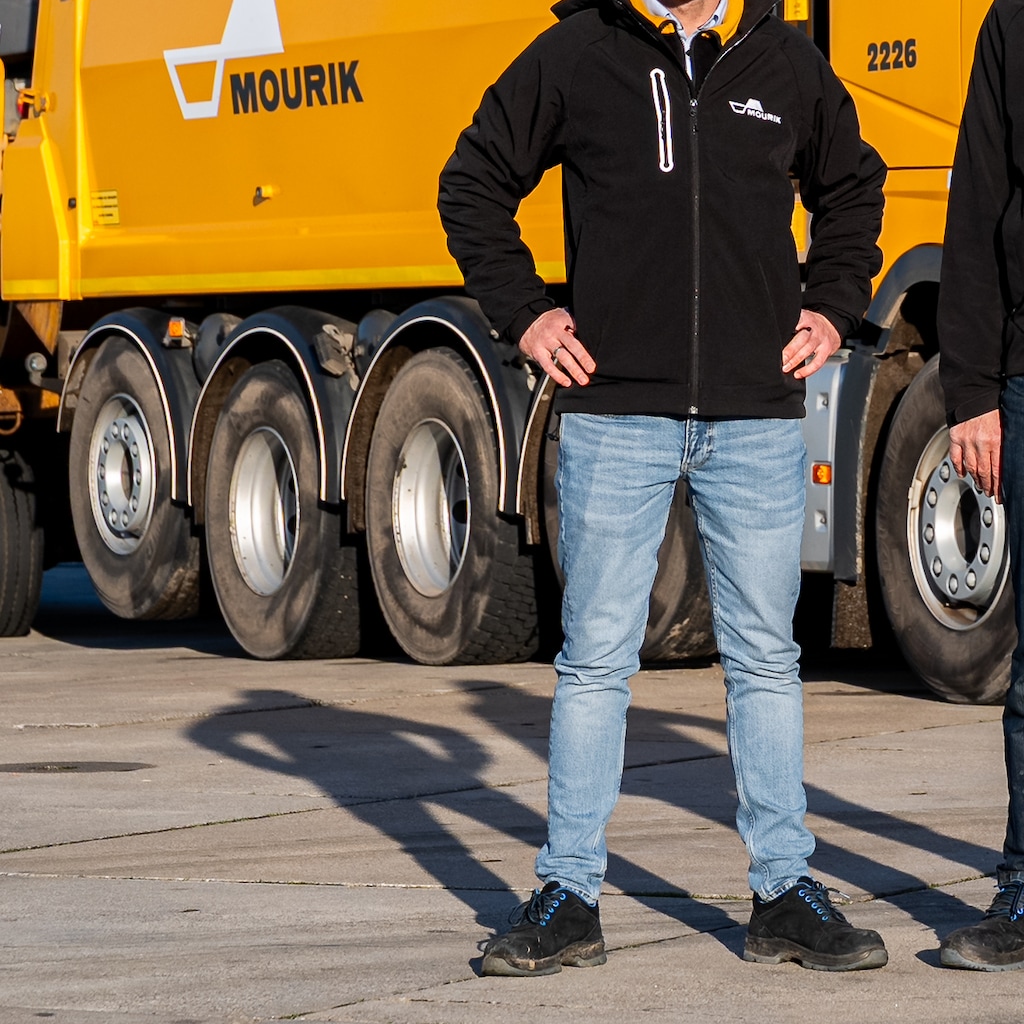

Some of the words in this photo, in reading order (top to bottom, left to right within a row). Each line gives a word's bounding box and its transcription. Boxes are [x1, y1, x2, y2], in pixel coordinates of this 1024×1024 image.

[867, 38, 917, 72] 2226
[229, 59, 364, 115] MOURIK
[747, 108, 781, 124] MOURIK
